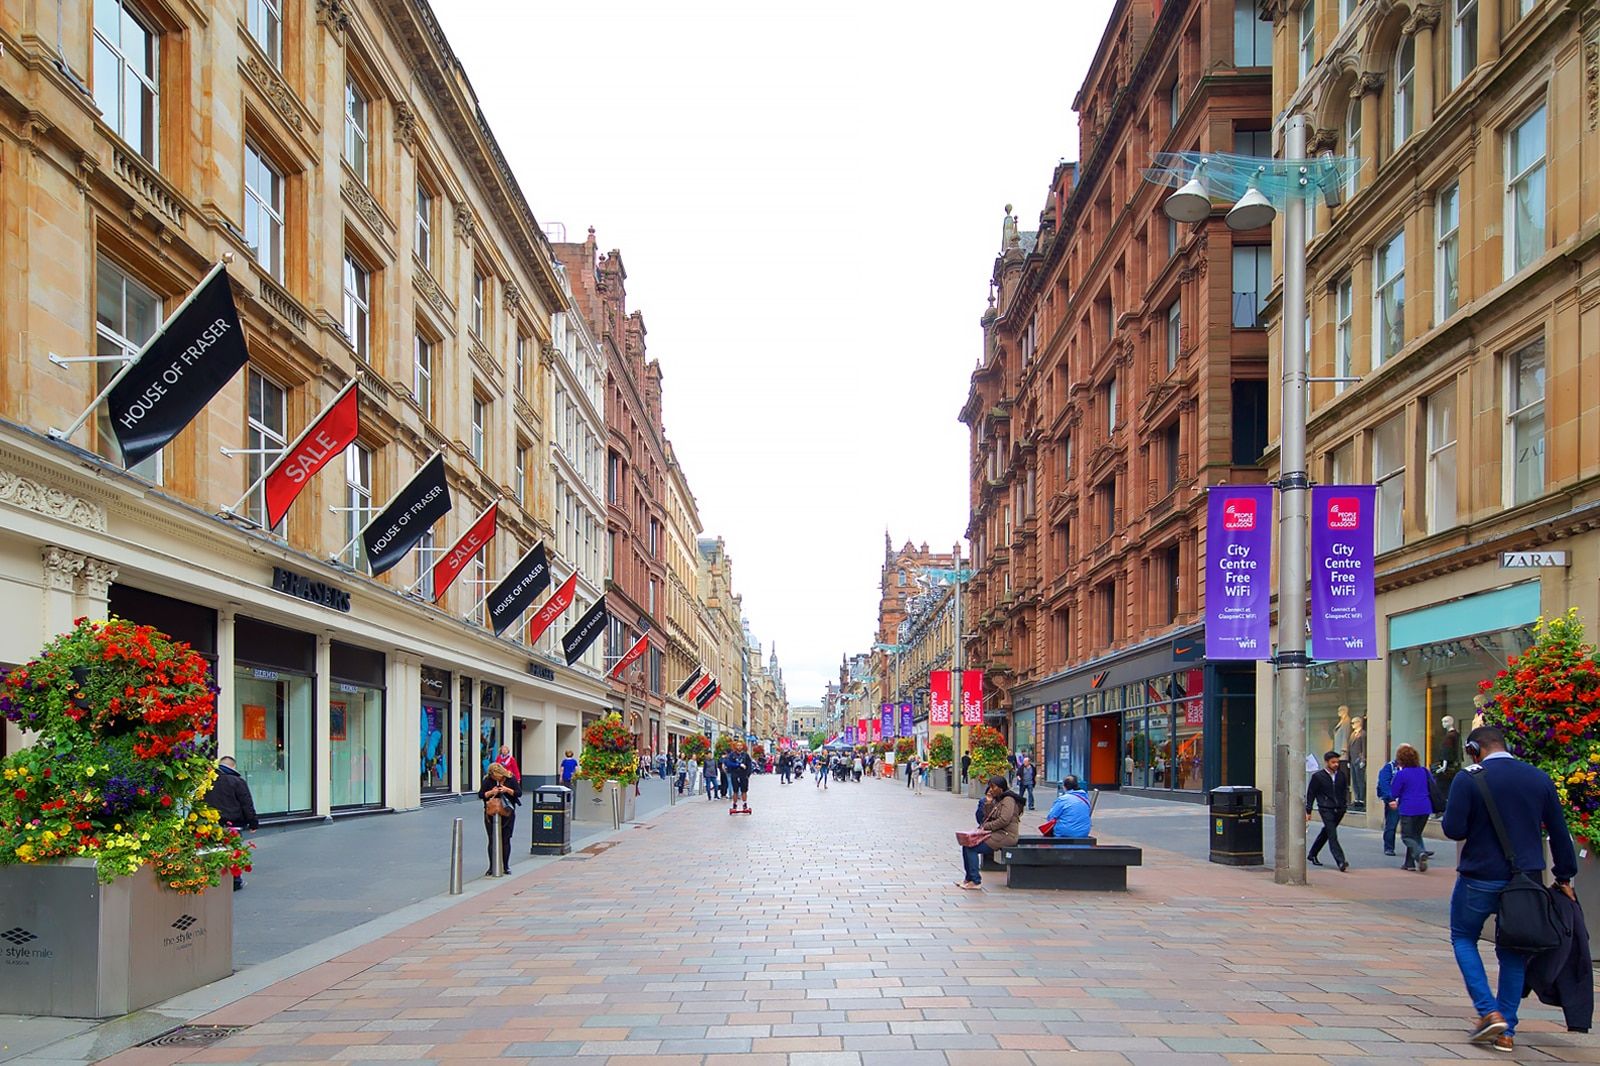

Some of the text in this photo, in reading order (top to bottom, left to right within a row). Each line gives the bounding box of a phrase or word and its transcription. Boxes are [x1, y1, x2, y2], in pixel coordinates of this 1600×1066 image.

[119, 318, 231, 429] HOUSE OF FRASER
[285, 431, 337, 483] SALE
[371, 485, 443, 555] HOUSE OF FRASER
[449, 534, 481, 569] SALE
[1227, 543, 1250, 558] City
[1332, 543, 1354, 557] City
[1219, 558, 1257, 570] Centre
[1324, 557, 1361, 569] Centre
[1504, 554, 1557, 567] ZARA
[1225, 571, 1251, 583] Free
[1331, 571, 1356, 583] Free
[272, 567, 351, 613] FRASERS
[493, 563, 545, 616] HOUSE OF FRASER
[1224, 585, 1251, 597] WiFi
[1330, 584, 1356, 596] WiFi
[541, 595, 568, 622] SALE
[566, 610, 604, 653] HOUSE OF FRASER
[1239, 639, 1257, 648] wifi
[1344, 639, 1363, 648] wifi
[163, 937, 175, 947] the
[175, 931, 192, 944] style
[6, 947, 30, 958] style
[31, 948, 54, 958] mile
